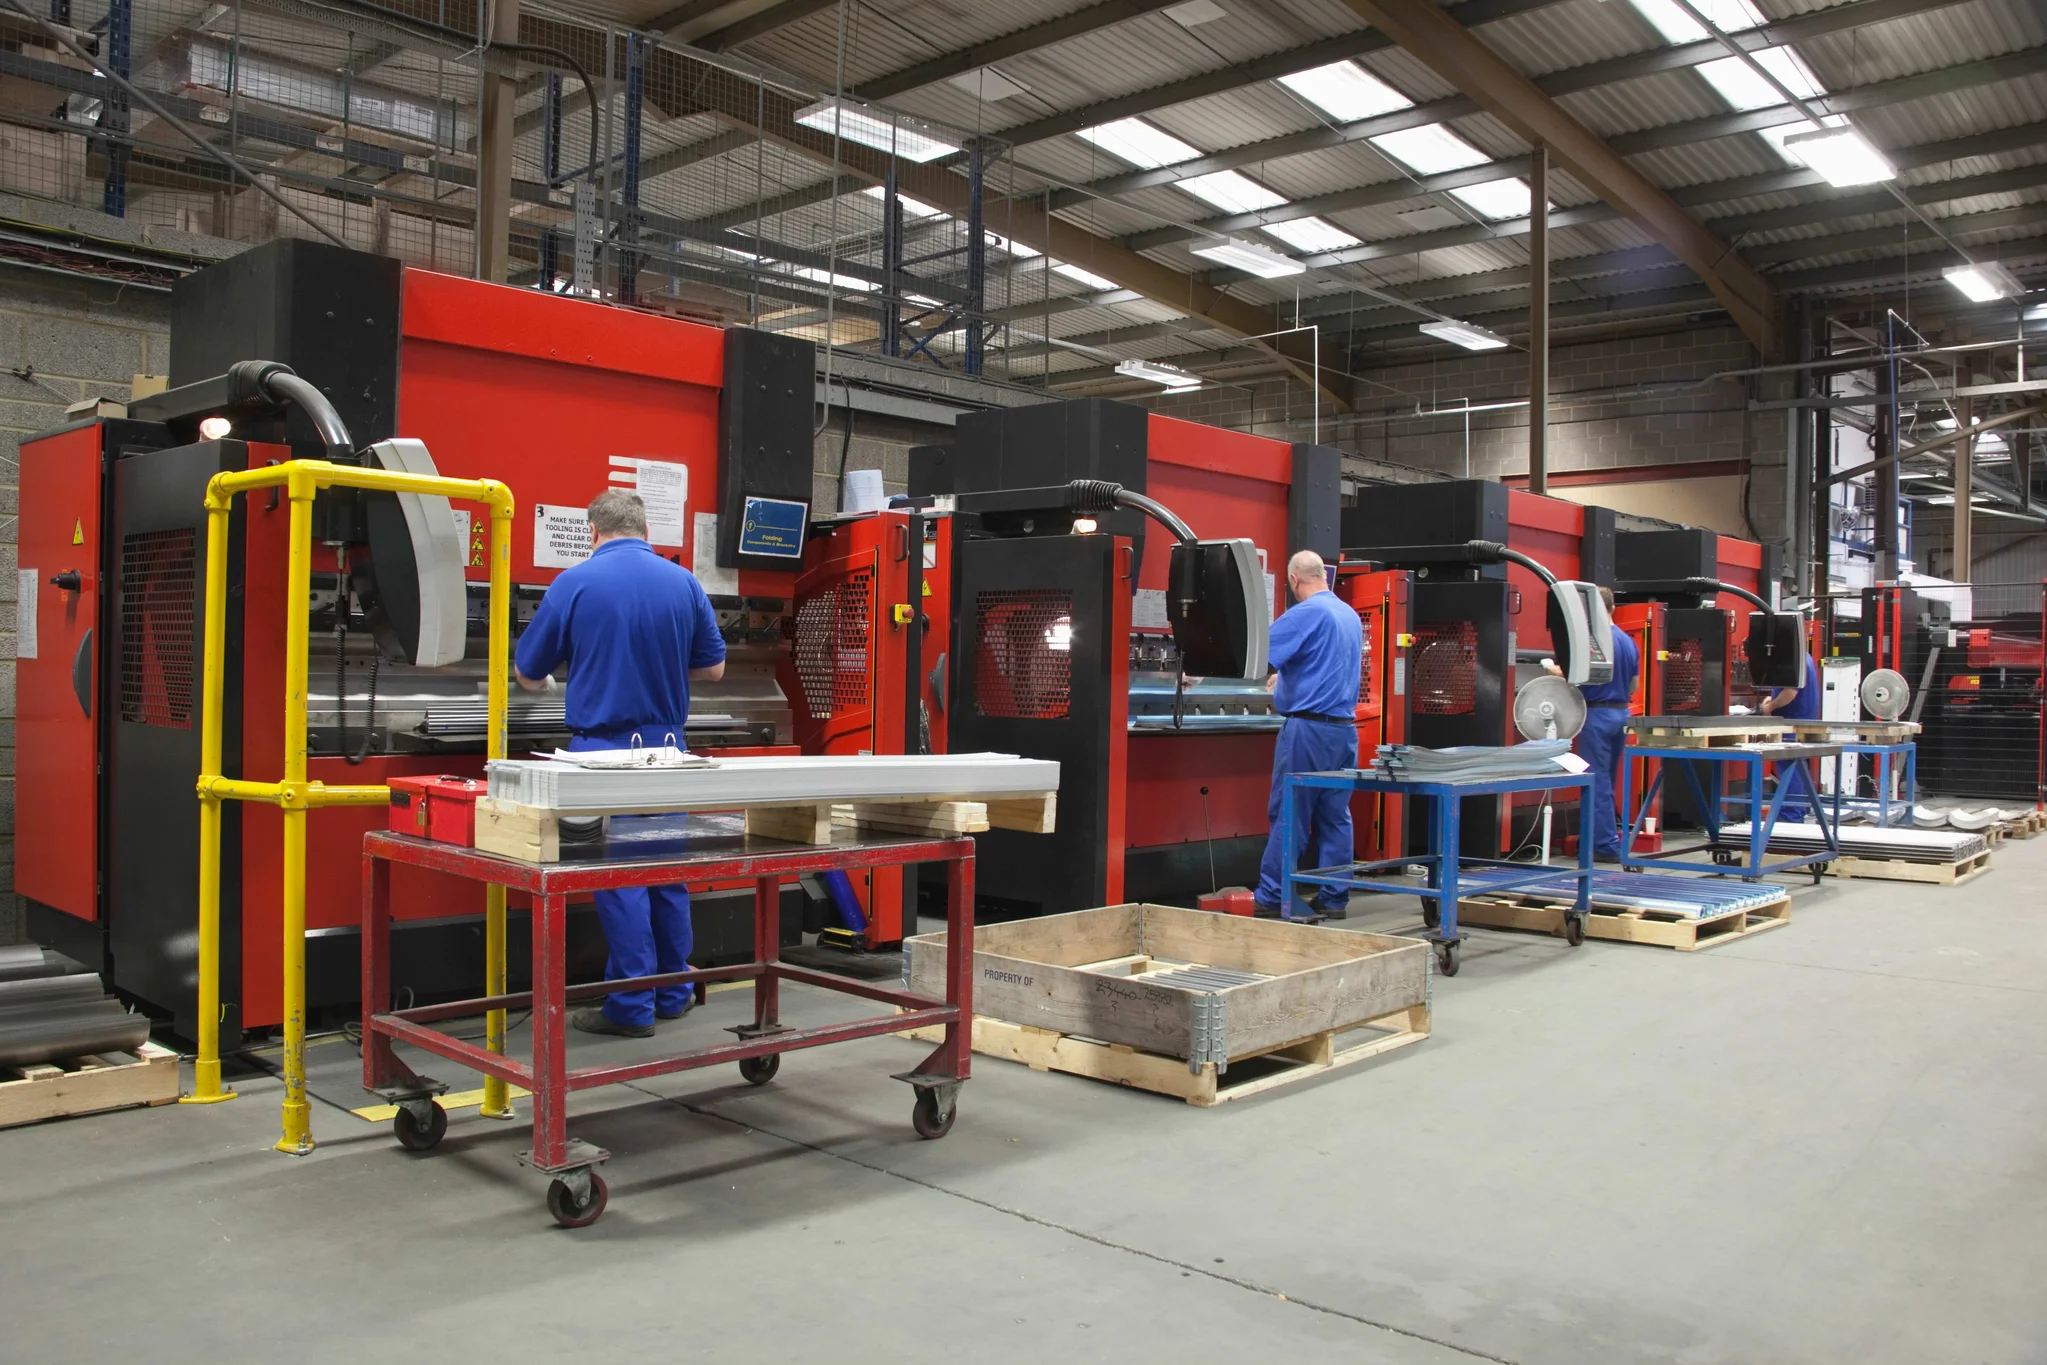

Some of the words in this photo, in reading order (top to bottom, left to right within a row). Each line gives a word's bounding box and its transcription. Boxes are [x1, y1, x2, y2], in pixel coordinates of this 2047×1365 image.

[536, 506, 544, 517] 3
[984, 968, 1022, 985] PROPERTY
[1023, 976, 1034, 986] OF
